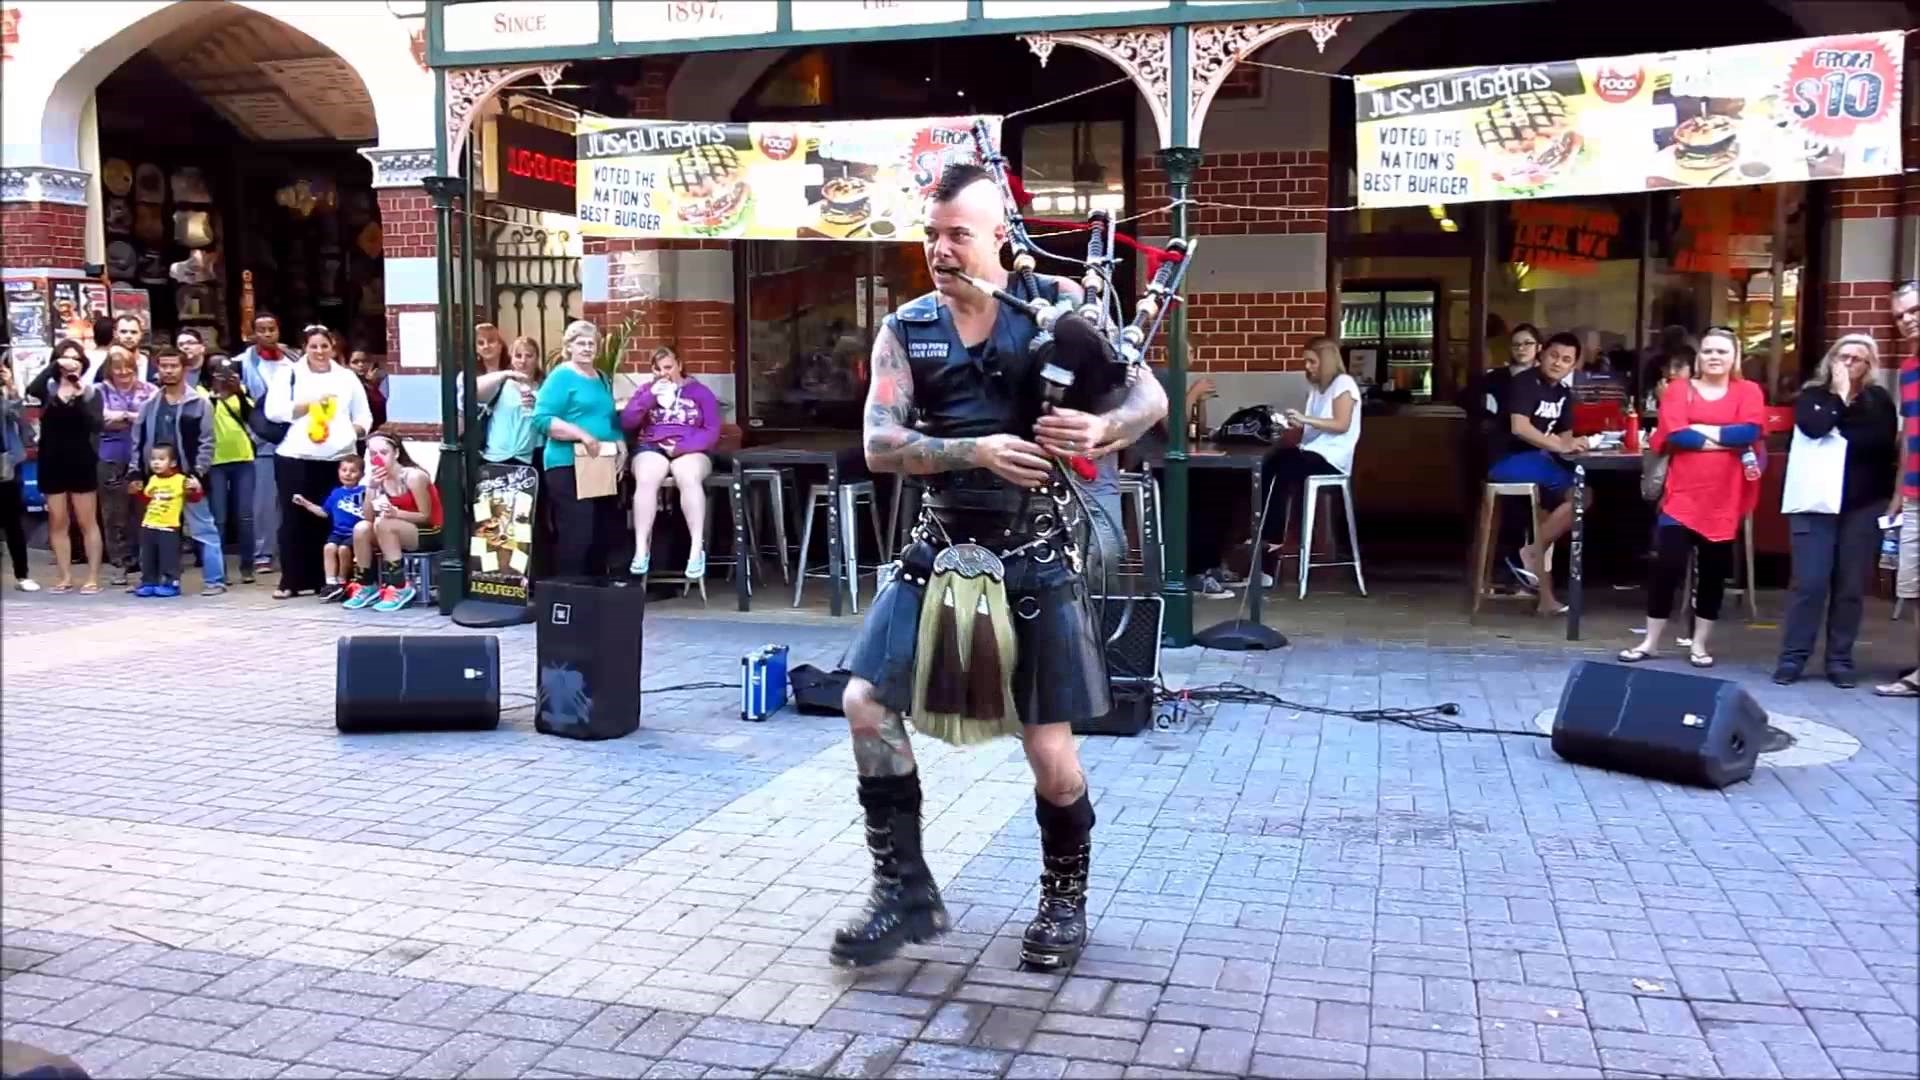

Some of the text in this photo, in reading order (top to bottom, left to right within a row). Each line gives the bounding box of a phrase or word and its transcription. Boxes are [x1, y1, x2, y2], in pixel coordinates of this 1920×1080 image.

[1815, 51, 1872, 68] FROM
[1793, 72, 1882, 118] $10
[1379, 127, 1462, 148] VOTED THE
[1381, 151, 1456, 170] NATION'S
[594, 165, 656, 189] VOTED THE
[1363, 173, 1469, 196] BEST BURGER
[594, 188, 651, 208] NATION'S
[580, 204, 661, 231] BEST BURGER
